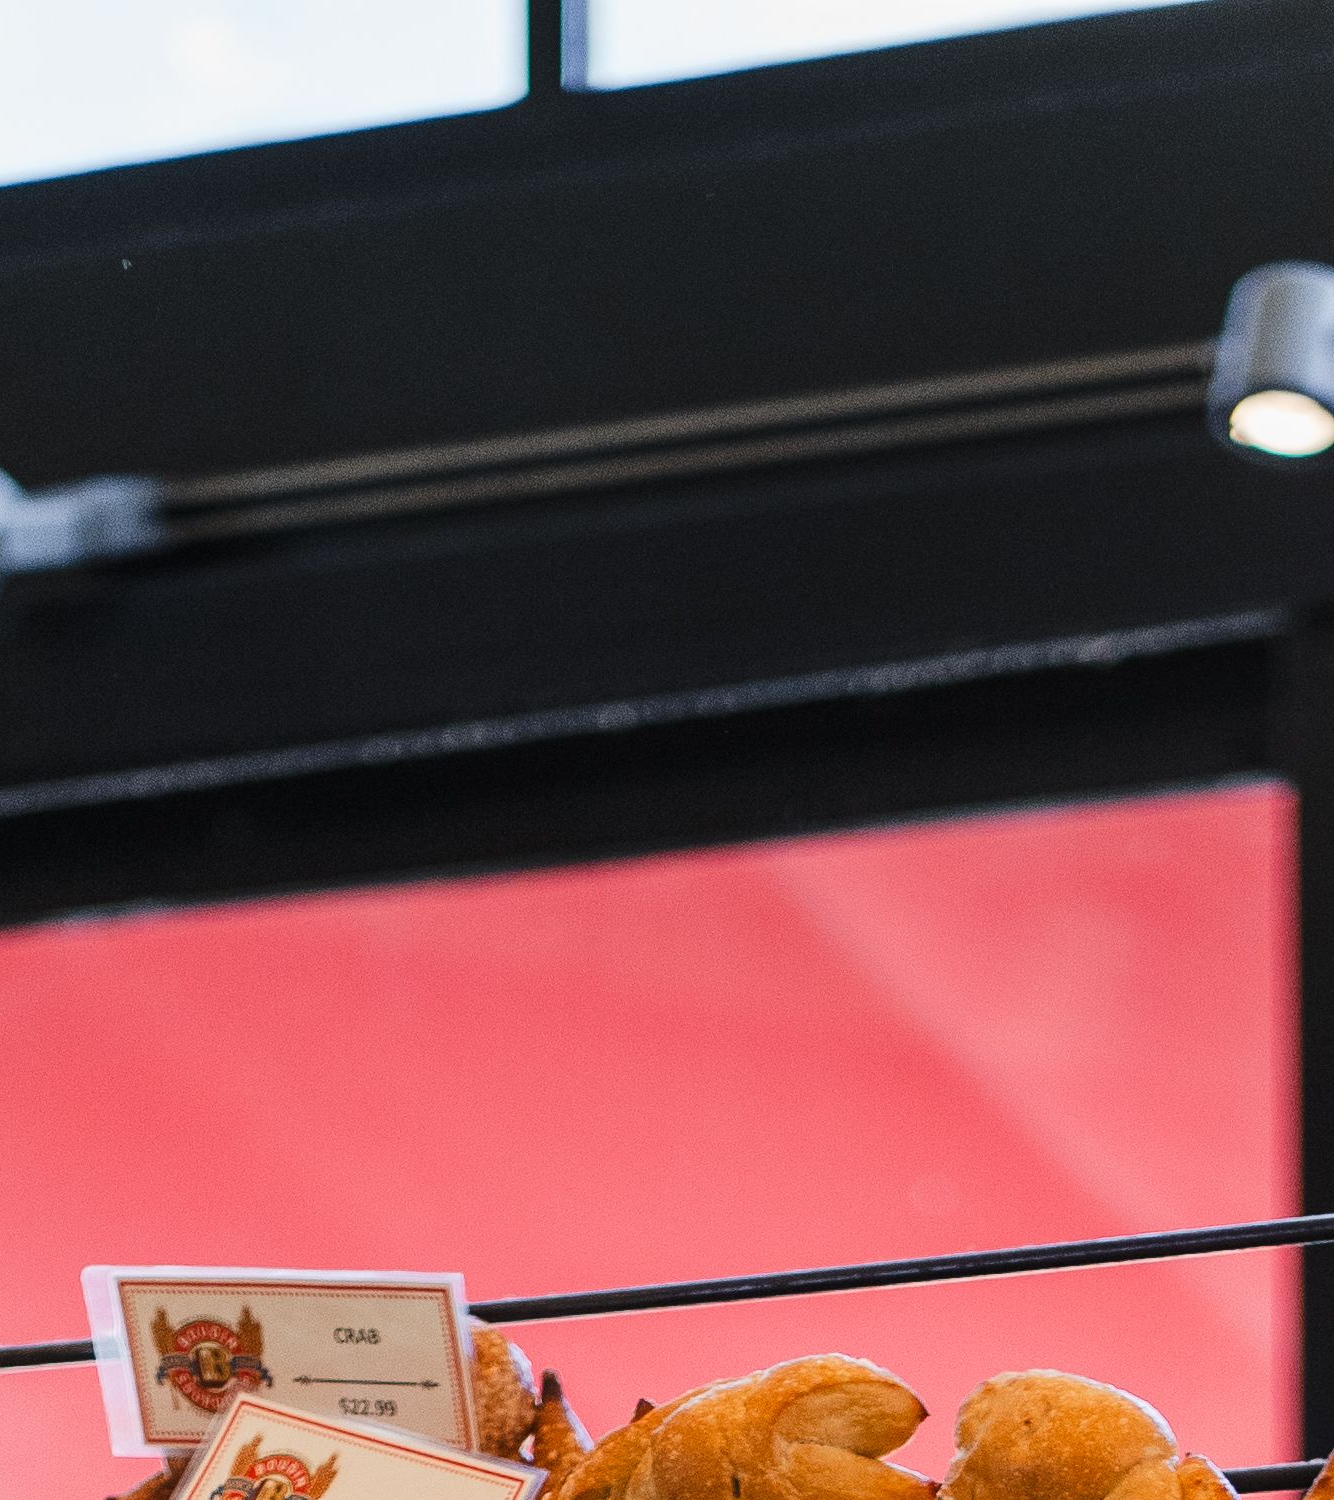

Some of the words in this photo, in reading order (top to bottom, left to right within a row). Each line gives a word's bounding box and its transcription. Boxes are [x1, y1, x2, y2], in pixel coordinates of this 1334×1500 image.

[333, 1326, 381, 1345] CRAB
[338, 1397, 398, 1417] $22.99
[254, 1459, 307, 1488] BOUDIN
